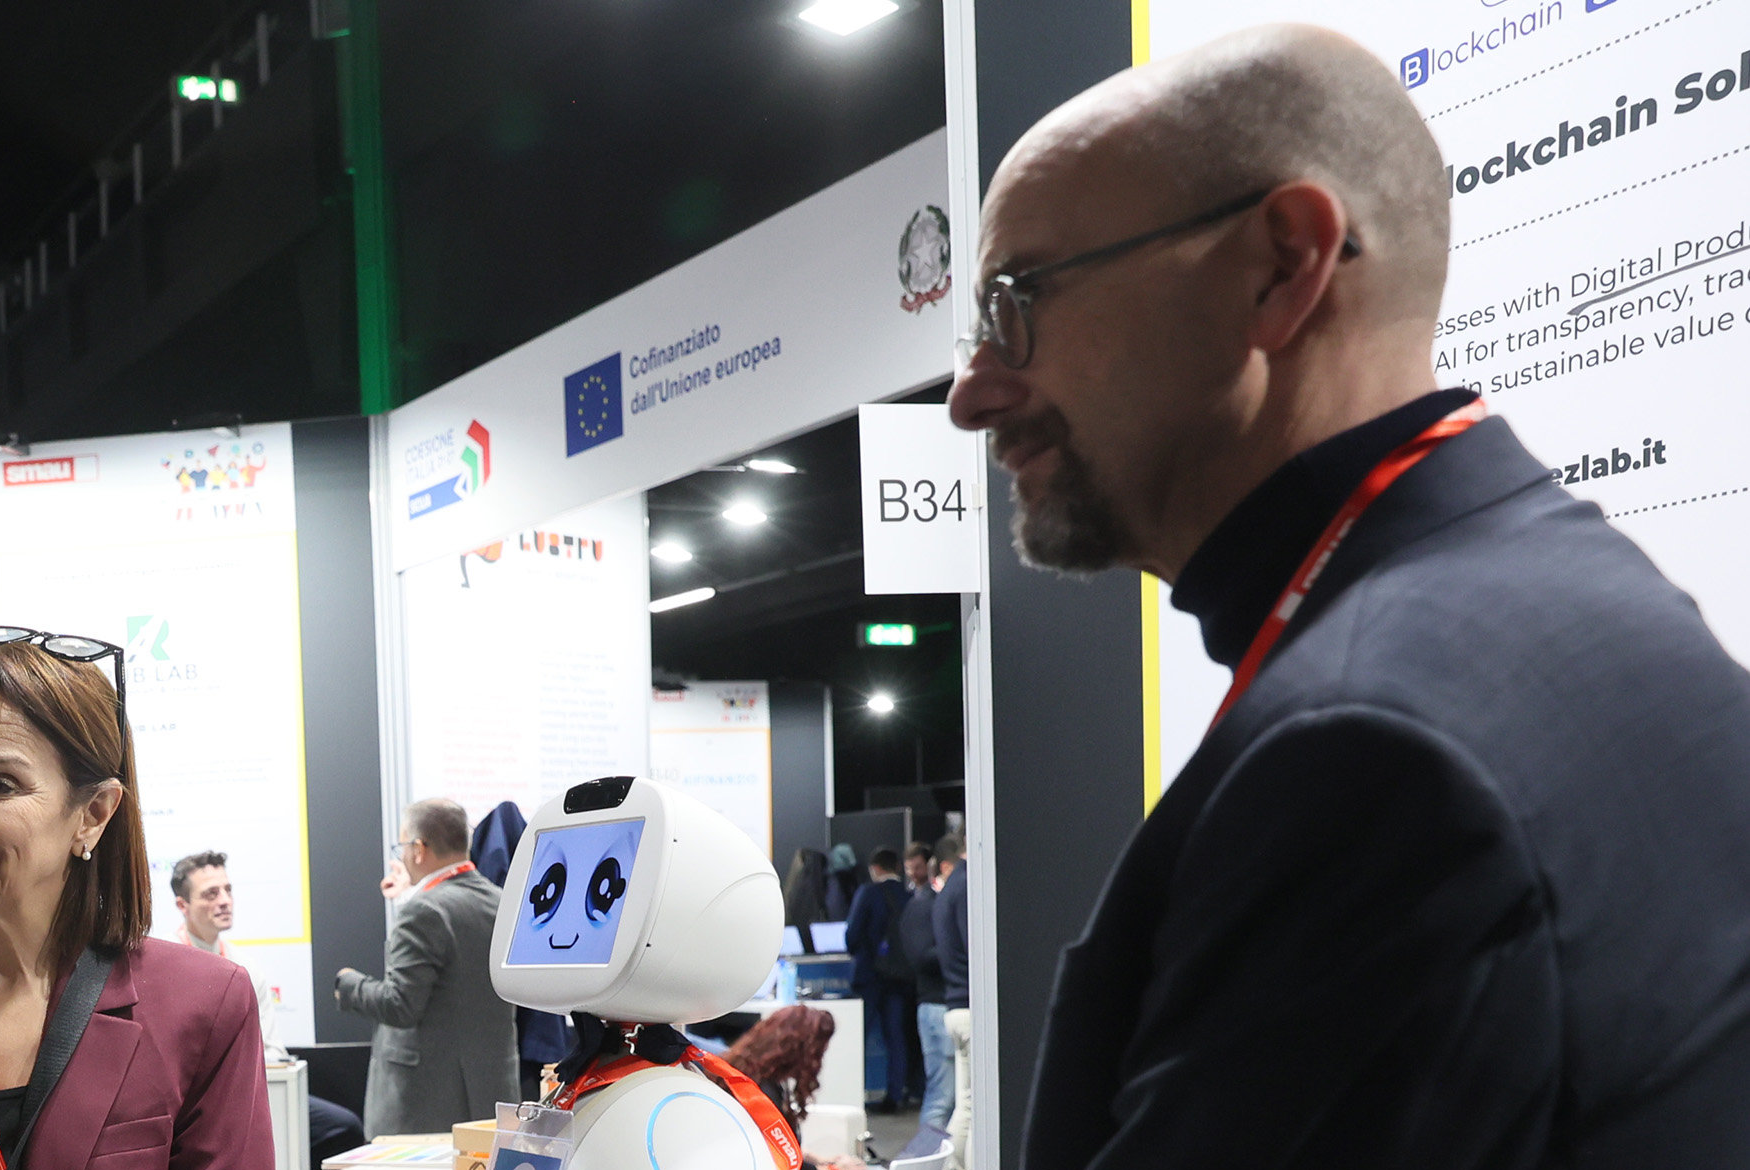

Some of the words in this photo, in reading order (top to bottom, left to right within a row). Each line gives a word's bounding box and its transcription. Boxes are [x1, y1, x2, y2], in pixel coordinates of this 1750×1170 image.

[1404, 1, 1562, 86] Blockchain
[1502, 282, 1560, 318] with
[1571, 247, 1662, 298] Digital
[1674, 220, 1750, 266] Prod
[629, 324, 721, 379] Cofinanziato
[1434, 347, 1457, 374] AI
[1465, 340, 1499, 365] for
[1506, 284, 1695, 353] transparency,
[1490, 334, 1645, 393] sustainable
[1653, 311, 1735, 350] value
[631, 366, 712, 415] dall'Unione
[715, 336, 781, 379] europea
[879, 479, 967, 522] B34
[771, 1127, 798, 1167] smau
